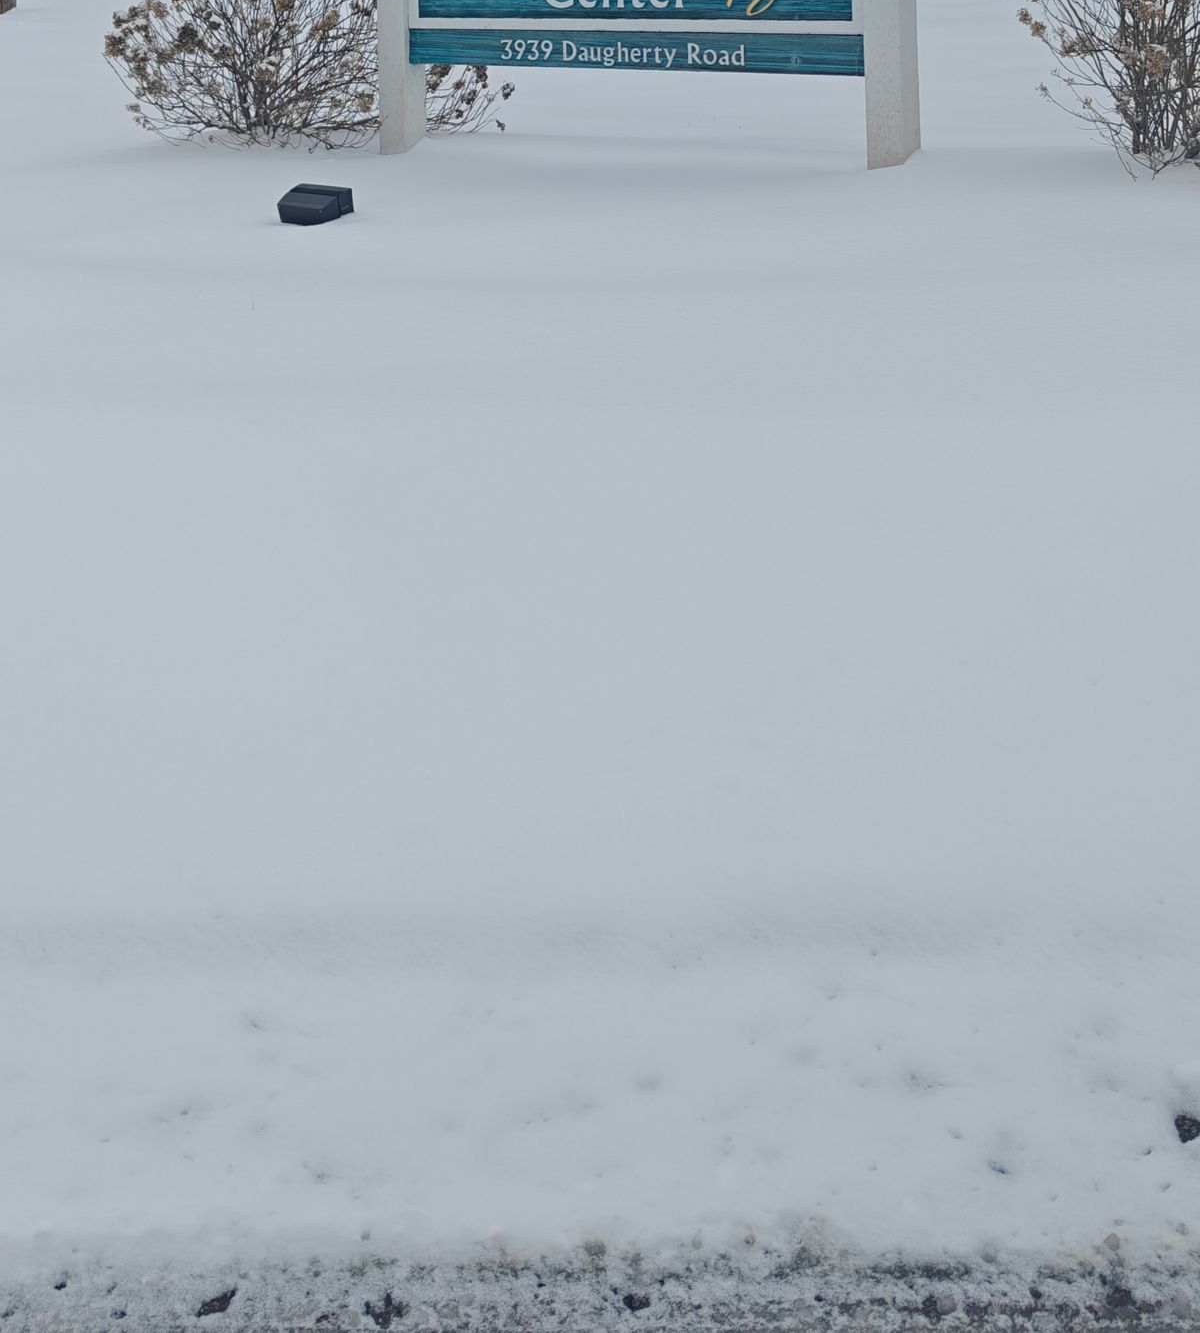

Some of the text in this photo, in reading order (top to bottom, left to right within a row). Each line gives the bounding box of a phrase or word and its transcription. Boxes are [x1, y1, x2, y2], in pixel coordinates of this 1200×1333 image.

[501, 40, 745, 68] 3939 Daugherty Road
